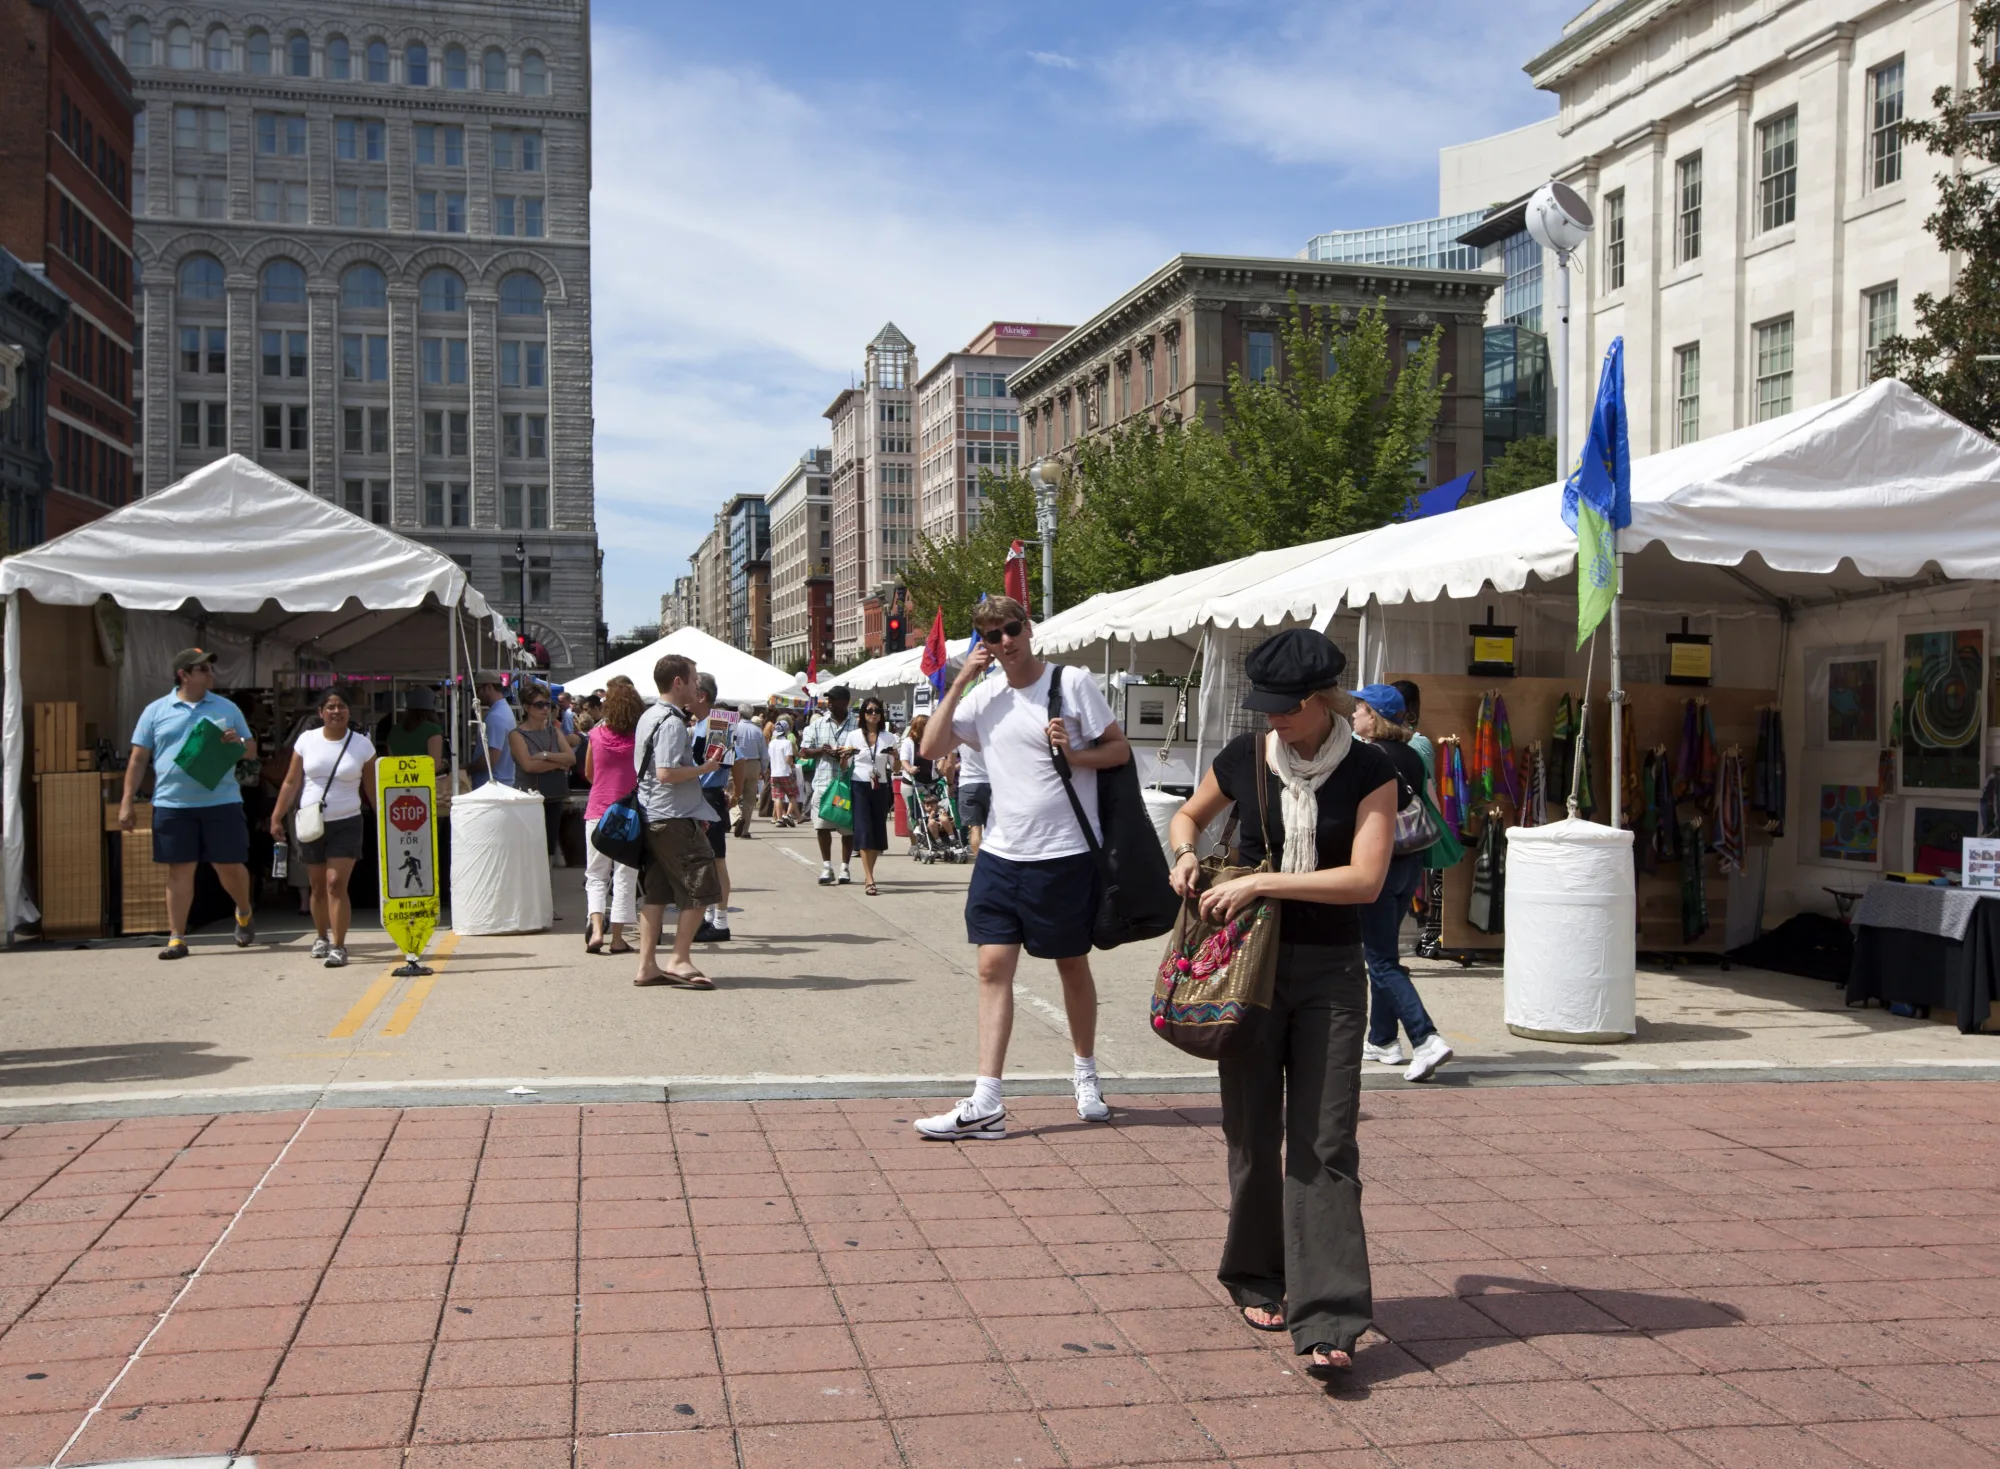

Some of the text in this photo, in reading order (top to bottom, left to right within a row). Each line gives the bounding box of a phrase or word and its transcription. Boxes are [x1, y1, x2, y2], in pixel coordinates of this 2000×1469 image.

[1002, 325, 1032, 336] Akridge
[398, 759, 417, 770] DC
[395, 773, 420, 784] LAW
[392, 805, 425, 821] STOP
[400, 836, 418, 845] FOR
